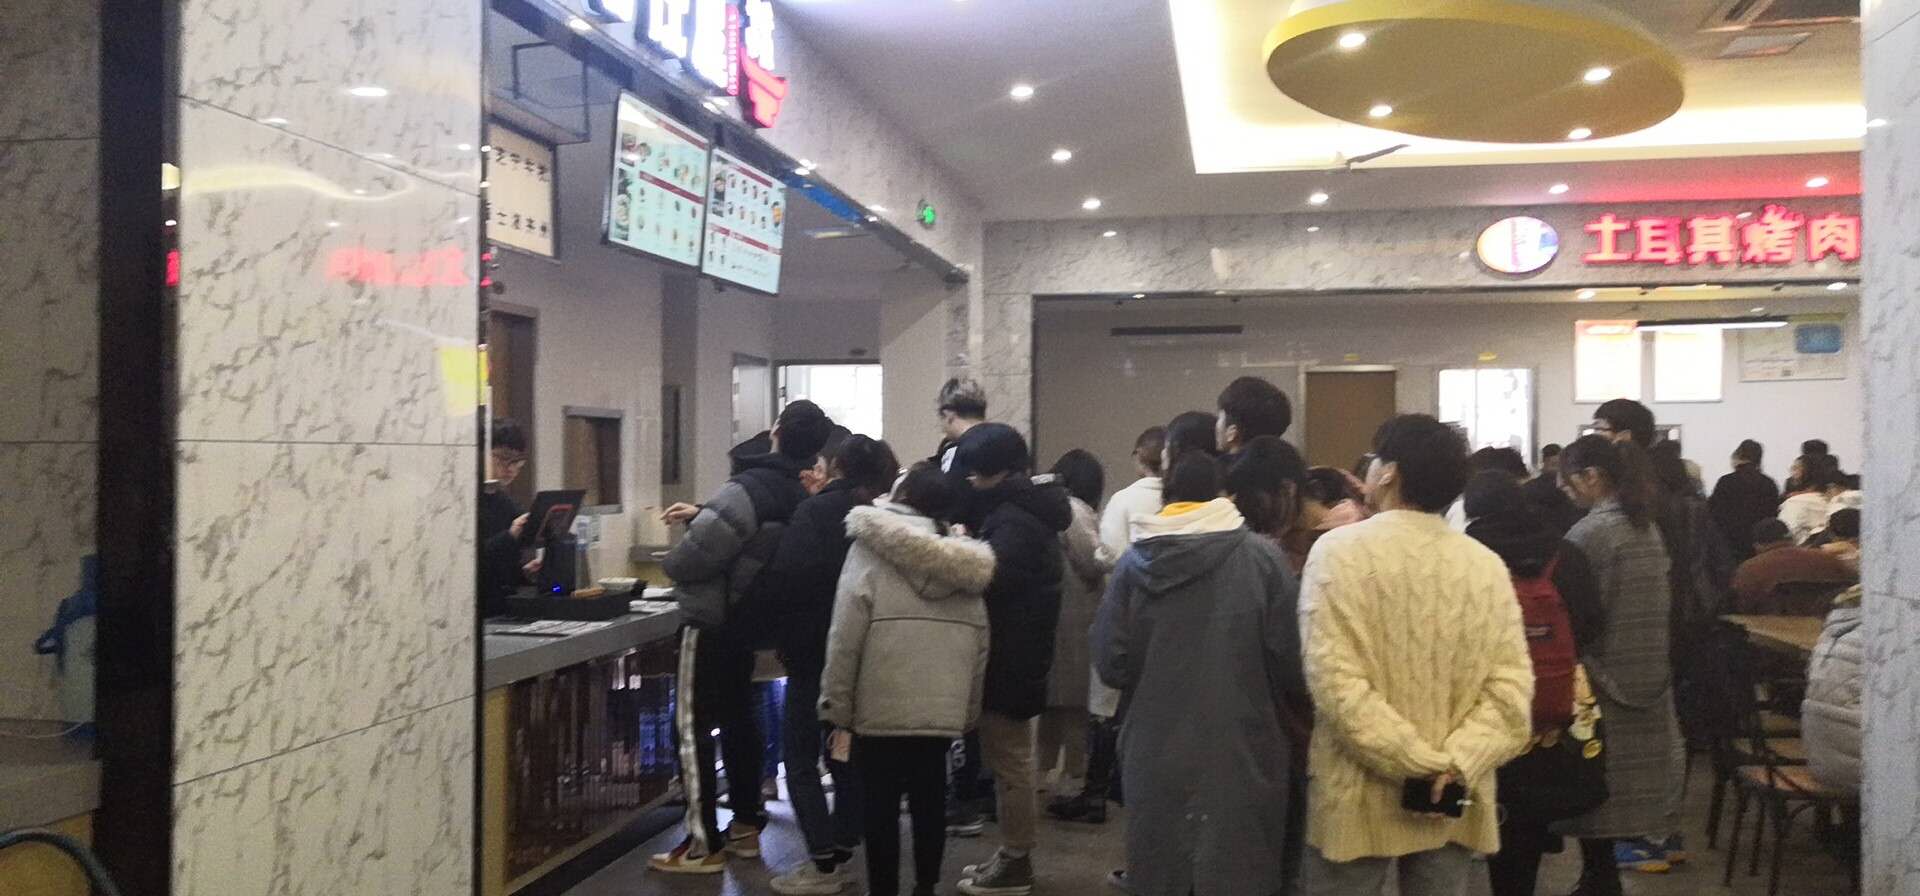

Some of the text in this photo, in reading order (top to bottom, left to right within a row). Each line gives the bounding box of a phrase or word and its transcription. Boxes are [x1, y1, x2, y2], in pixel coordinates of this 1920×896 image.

[1583, 205, 1860, 266] 土耳其烤肉
